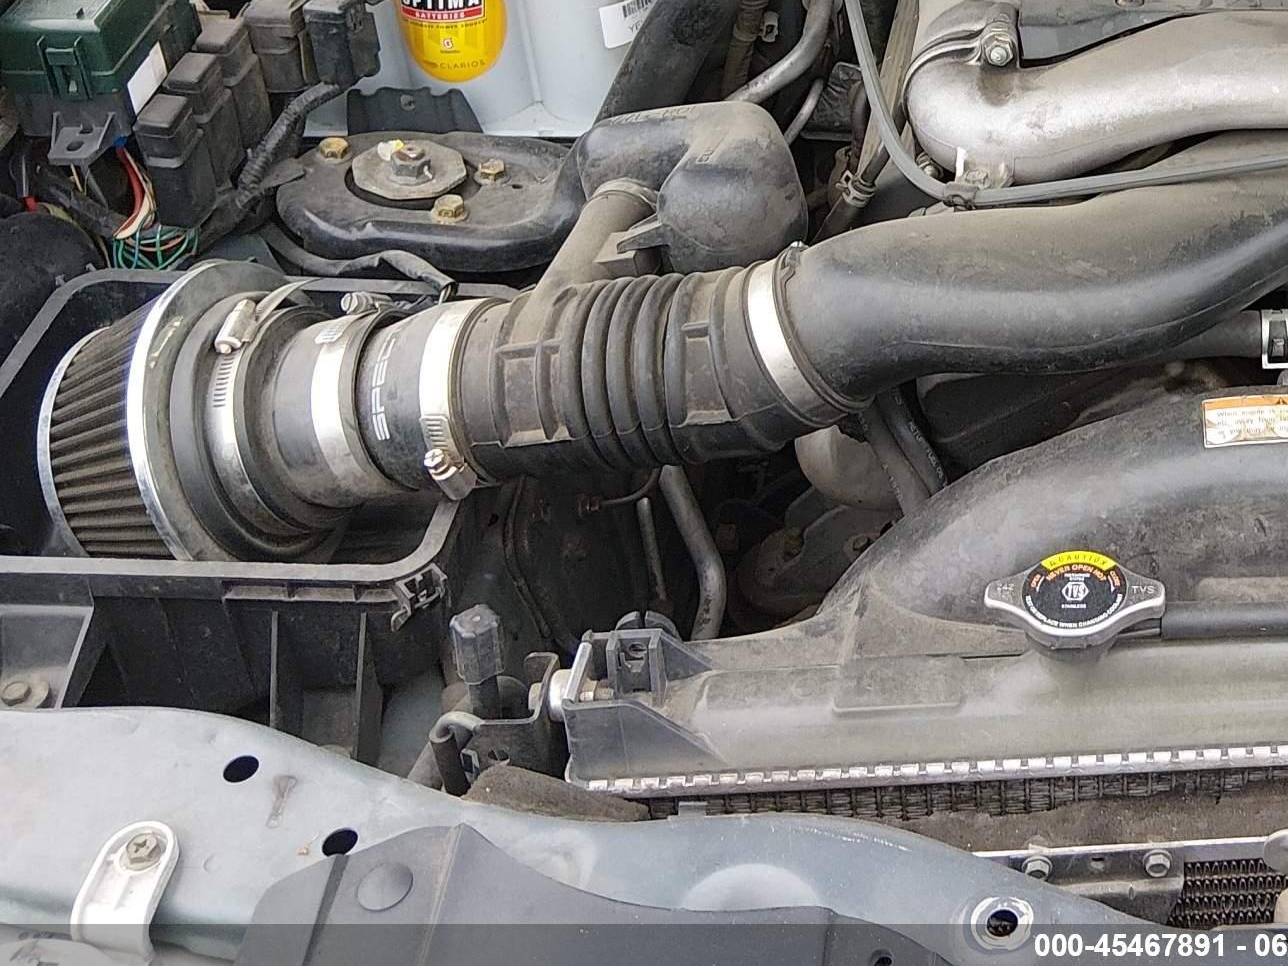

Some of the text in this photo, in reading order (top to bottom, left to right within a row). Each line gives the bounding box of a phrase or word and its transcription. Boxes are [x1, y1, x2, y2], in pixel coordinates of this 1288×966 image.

[415, 11, 466, 20] BATTERIES
[439, 60, 486, 70] CLARIOS
[1058, 553, 1107, 567] CAUTION
[1045, 565, 1071, 581] NEVER
[1071, 563, 1094, 574] OPEN
[1093, 567, 1108, 581] HOT
[1030, 574, 1042, 589] OPEN
[1067, 583, 1085, 599] TVS
[1131, 585, 1155, 594] TVS
